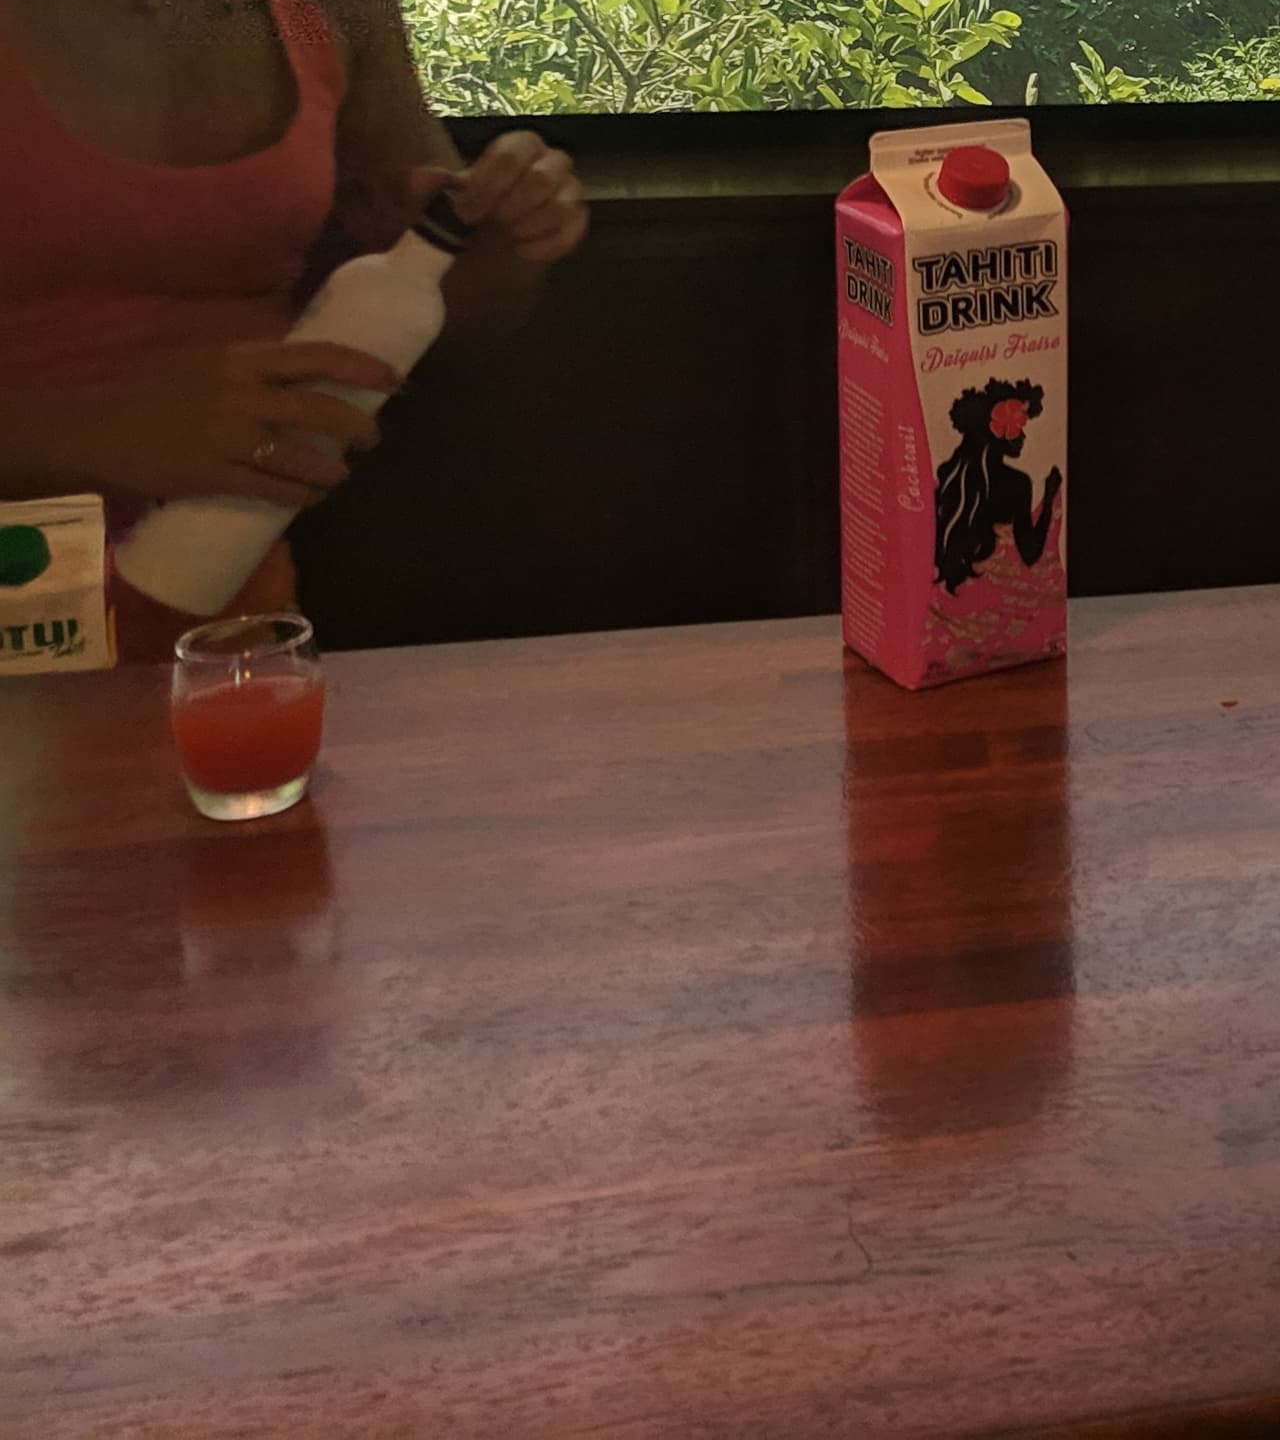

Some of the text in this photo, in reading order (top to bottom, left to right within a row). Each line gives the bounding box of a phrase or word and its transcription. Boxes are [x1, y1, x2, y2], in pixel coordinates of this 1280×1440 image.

[843, 236, 894, 289] TAHITI
[912, 240, 1058, 294] TAHITI
[846, 272, 894, 327] DRINK
[918, 280, 1059, 336] DRINK
[1003, 333, 1061, 359] Fraise
